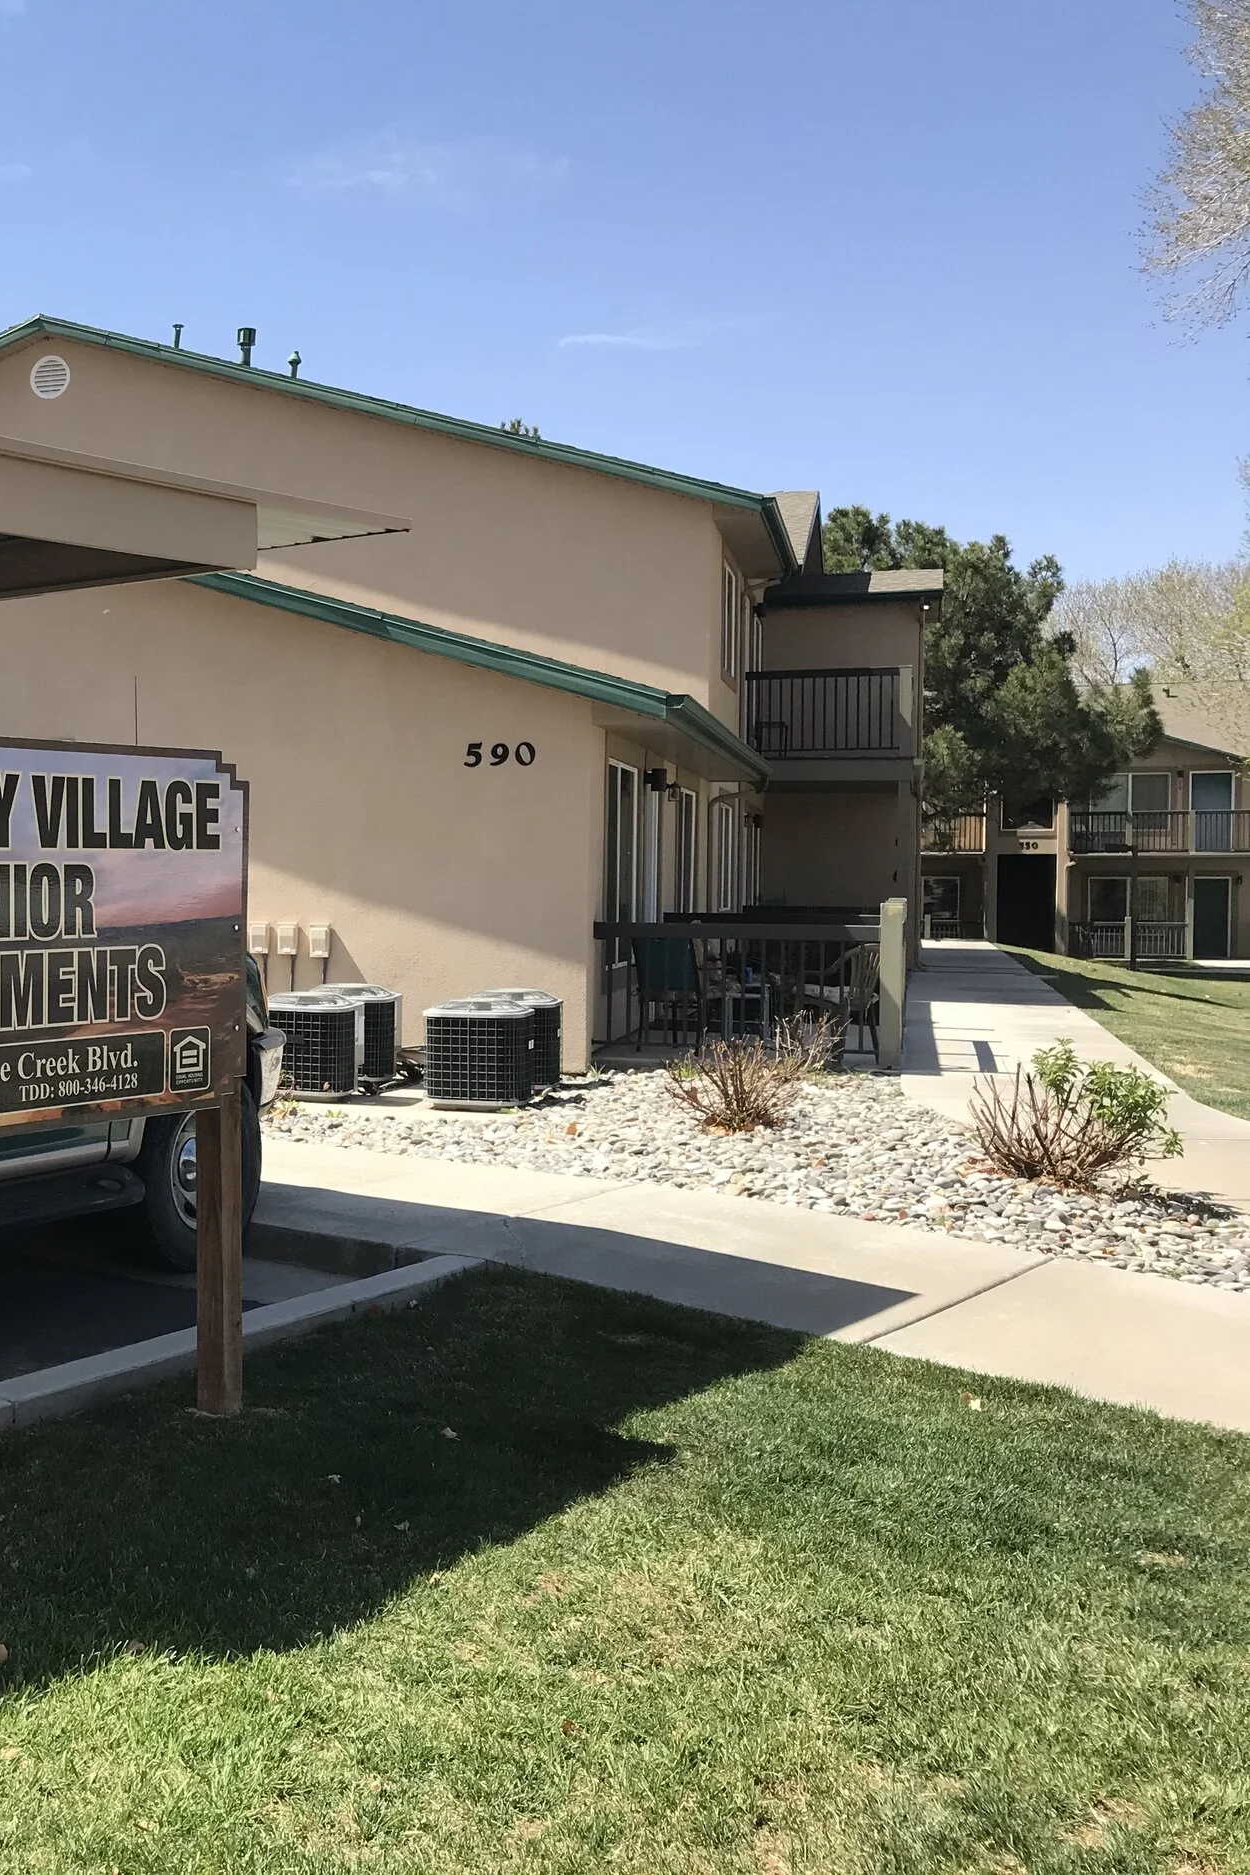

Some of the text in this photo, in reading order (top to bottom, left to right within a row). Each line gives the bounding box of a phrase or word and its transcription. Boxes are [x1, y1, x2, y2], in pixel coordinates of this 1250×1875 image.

[463, 742, 536, 767] 590
[31, 770, 223, 852] VILLAGE
[17, 1049, 81, 1080] Creek
[86, 1043, 138, 1073] Blvd.
[19, 1073, 138, 1102] TDD: 800-346-4128
